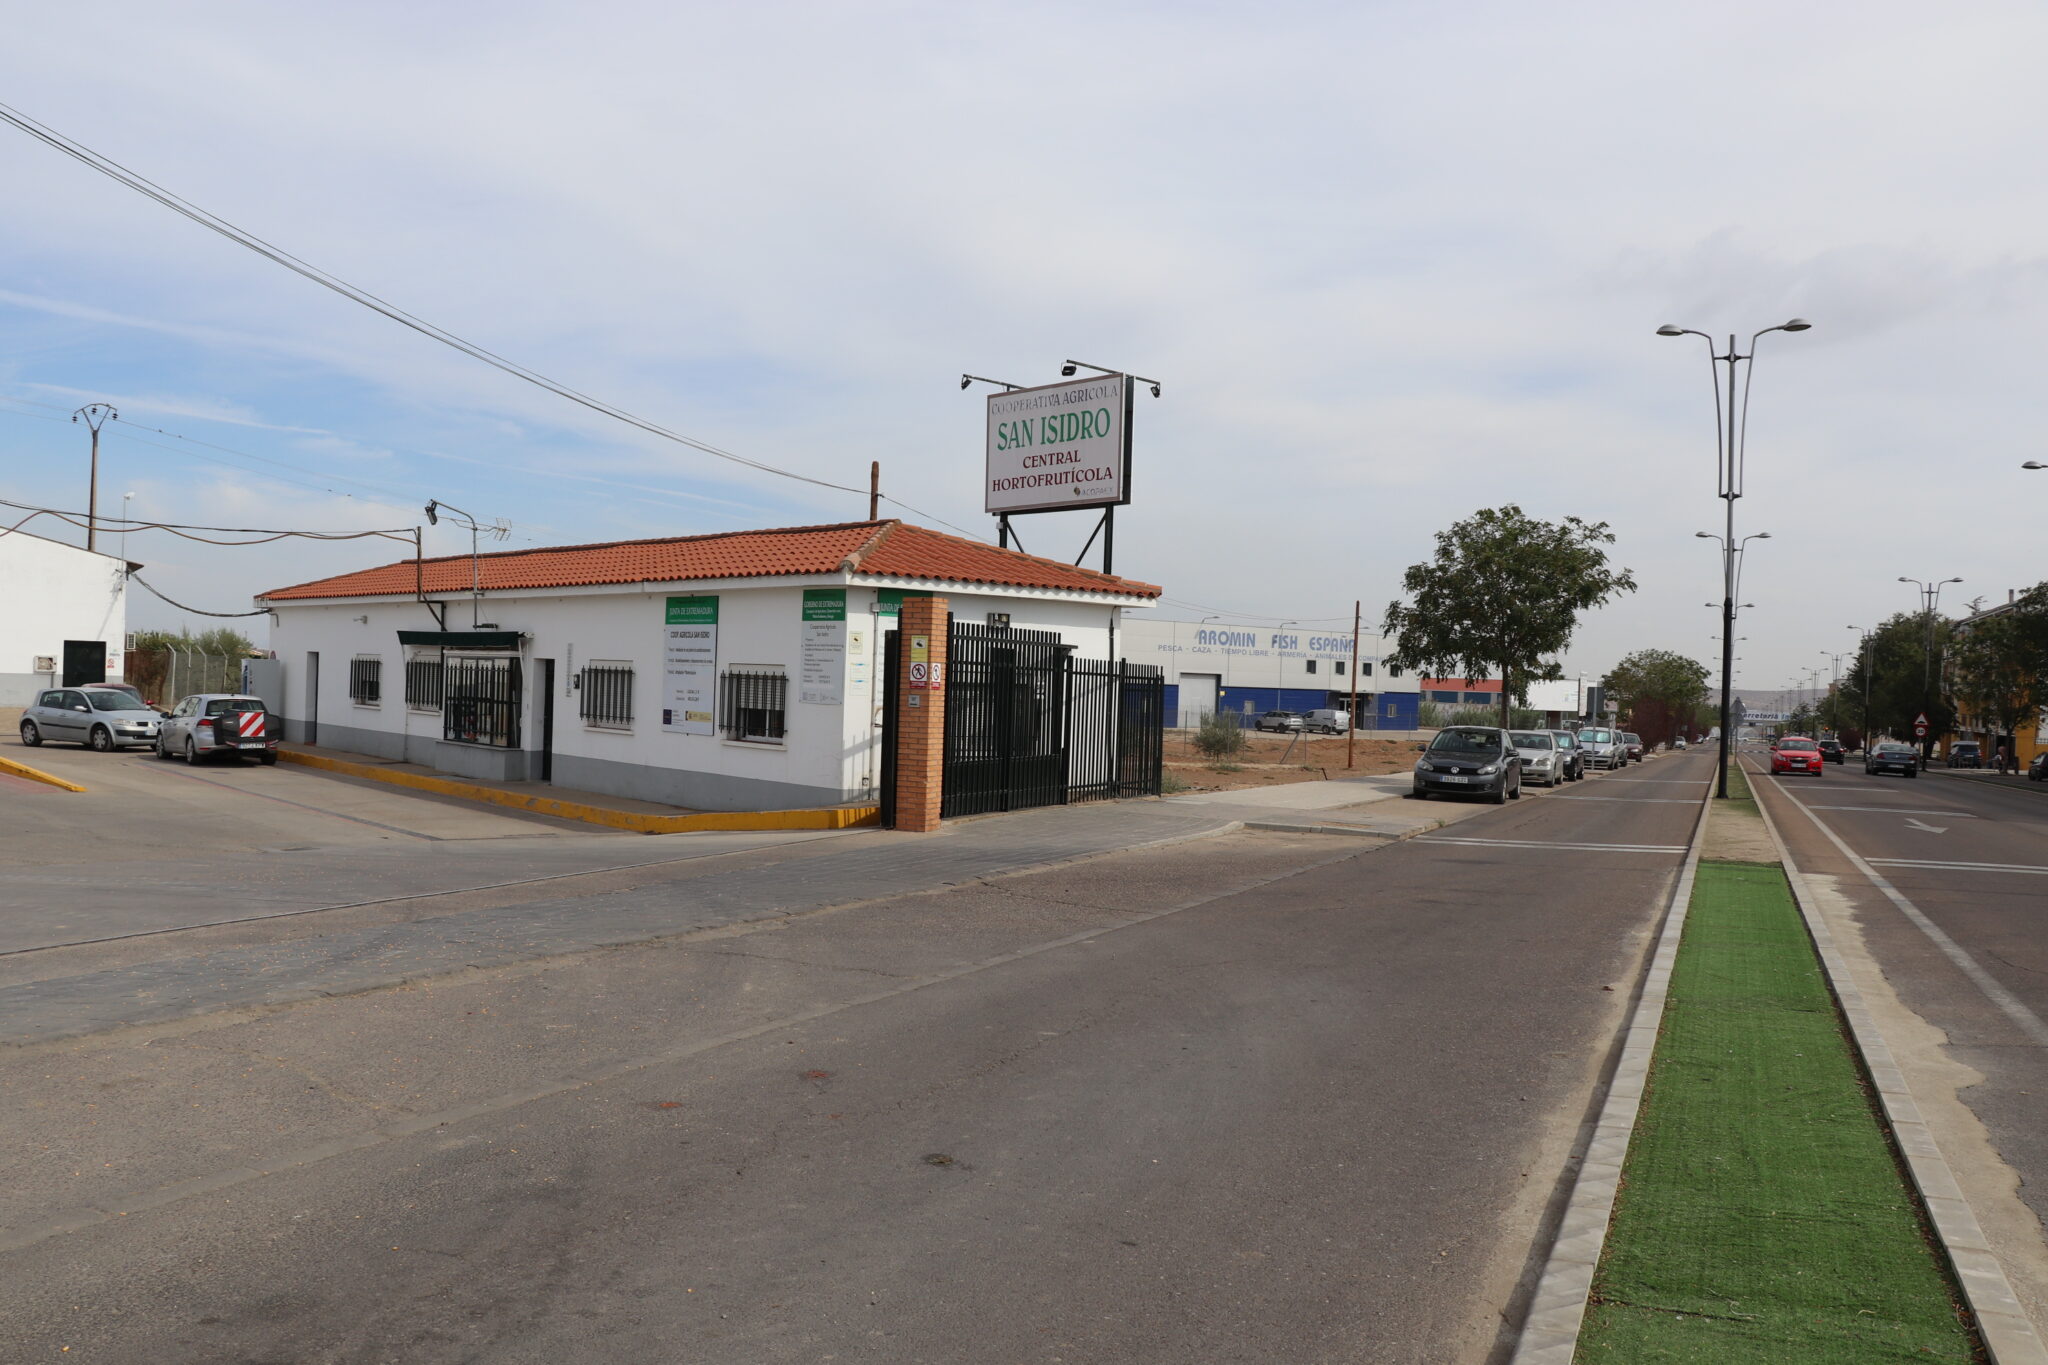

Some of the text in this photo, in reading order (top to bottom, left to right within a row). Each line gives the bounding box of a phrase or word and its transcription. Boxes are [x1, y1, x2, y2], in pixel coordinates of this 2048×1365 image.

[991, 394, 1061, 415] COOPERATIVA
[997, 407, 1111, 451] SAN ISIDRO
[1022, 450, 1081, 469] CENTRAL
[992, 466, 1113, 492] HORTOFRUTÍCOLA
[1198, 629, 1256, 648] AROMIN
[1271, 634, 1298, 650] FISH
[1221, 648, 1247, 656] TIEMPO
[1315, 653, 1347, 661] ANIMALES
